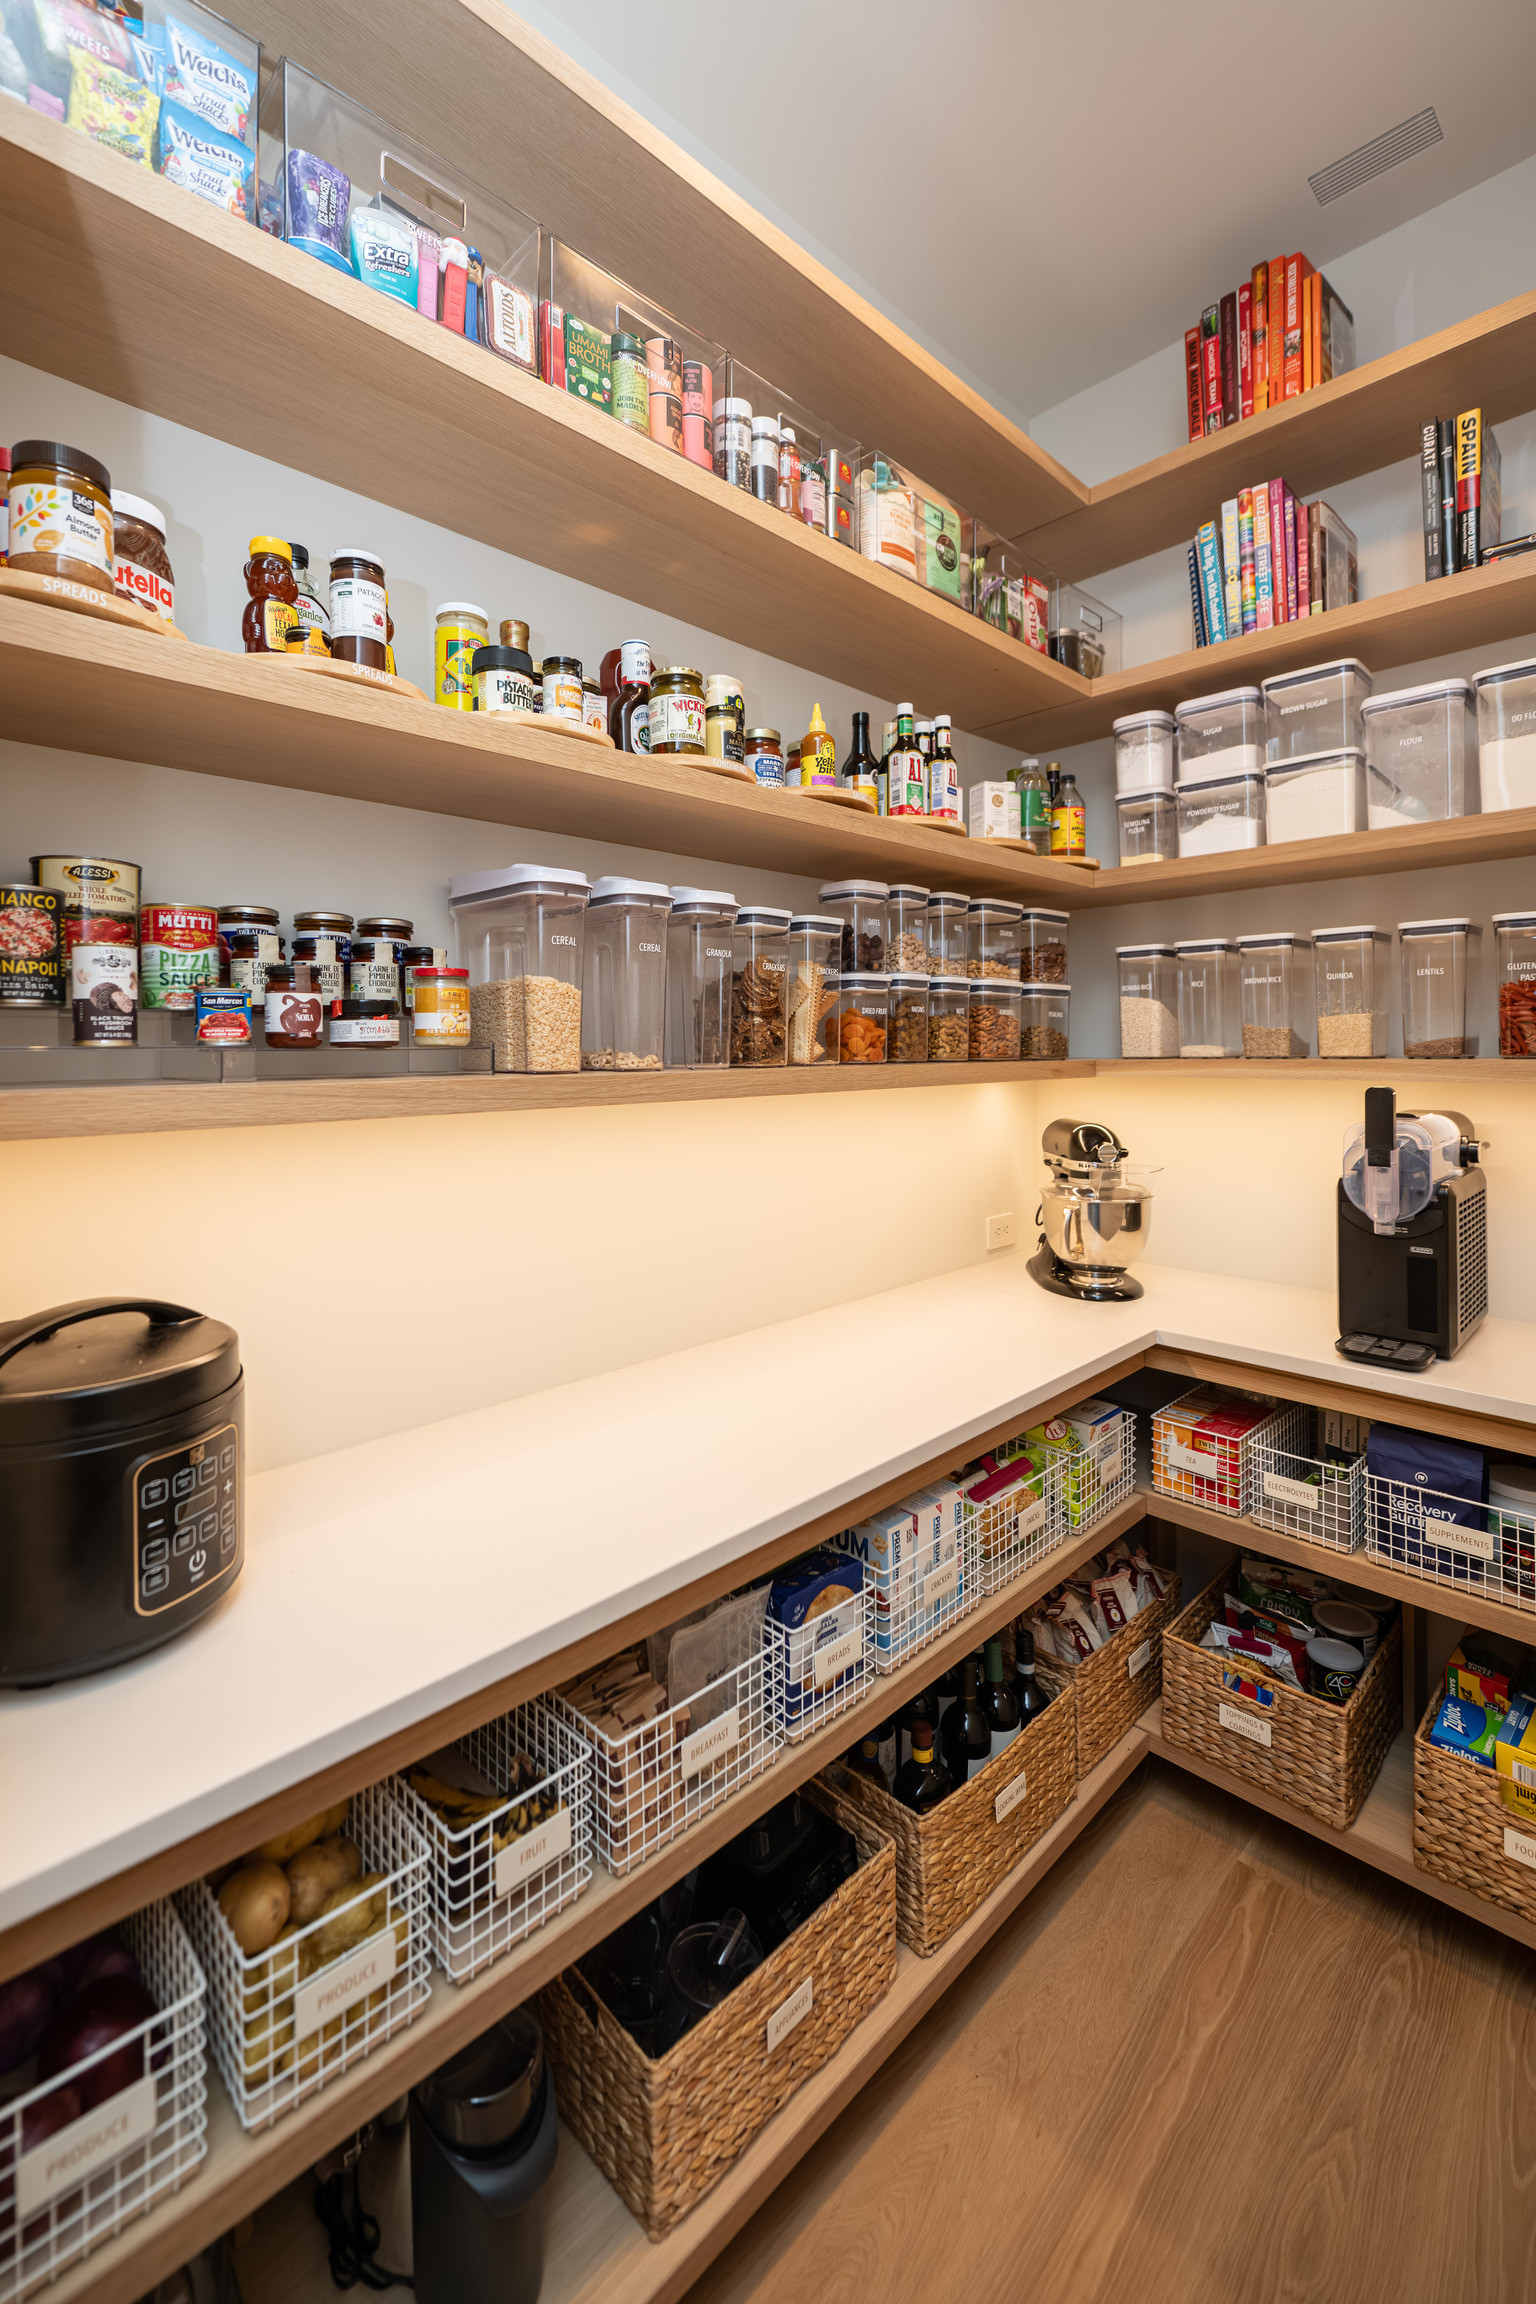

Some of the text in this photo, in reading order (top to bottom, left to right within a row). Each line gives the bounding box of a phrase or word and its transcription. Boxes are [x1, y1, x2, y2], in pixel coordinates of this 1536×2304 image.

[175, 41, 248, 95] Welch's
[191, 95, 230, 126] Snacks
[200, 92, 227, 112] Fruit
[189, 171, 228, 198] Snacks
[198, 168, 225, 187] Fruit
[319, 175, 333, 213] BREAKERS
[330, 186, 338, 213] CUBES
[407, 221, 443, 252] SWEETS
[364, 243, 411, 267] Extra
[365, 260, 411, 279] Refreshers
[500, 289, 517, 353] ALTOIDS
[572, 331, 609, 360] UMAMI
[1188, 341, 1198, 365] MAN
[1272, 315, 1281, 377] CHAMELEON
[568, 340, 611, 375] BROTH
[618, 351, 637, 370] SPICE
[637, 366, 673, 391] OVERFLOW
[1207, 342, 1218, 405] HOMESICK TEXAN
[616, 402, 647, 416] MADNESS
[617, 395, 646, 407] JOIN THE
[1189, 367, 1201, 434] MADE MEALS
[1462, 418, 1478, 476] SPAIN
[74, 494, 94, 512] 365
[65, 513, 101, 535] Almond
[1256, 494, 1267, 546] ELIZABETH
[1467, 510, 1477, 534] MARIO
[70, 525, 98, 541] Butter
[1272, 504, 1284, 605] EXTRAORDINARY CELEBRATIONS
[1467, 535, 1476, 560] BATALI
[1225, 515, 1239, 623] BASQUE COUNTRY
[1258, 548, 1268, 583] STREET
[43, 577, 108, 607] SPREADS
[114, 565, 173, 608] utella
[1203, 542, 1221, 633] The Big Fun Kids Cookbook
[274, 611, 294, 624] LOCAL
[1028, 601, 1039, 645] JELL-O
[352, 664, 393, 686] SPREADS
[503, 692, 533, 710] BUTTER
[1280, 698, 1328, 716] BROWN SUGAR
[1524, 711, 1536, 720] FLO
[1202, 726, 1223, 737] SUGAR
[1399, 735, 1423, 747] FLOUR
[1186, 802, 1240, 818] POWDERED SUGAR
[1123, 818, 1151, 829] SEMOLINA
[1128, 826, 1145, 835] FLOUR
[72, 866, 112, 880] ALESSI
[78, 885, 106, 895] WHOLE
[87, 893, 127, 904] TOMATOES
[0, 892, 57, 910] IANCO
[158, 914, 213, 930] MUTTI
[867, 918, 881, 927] DATES
[551, 935, 577, 947] CEREAL
[639, 942, 662, 953] CEREAL
[159, 950, 211, 972] PIZZA
[706, 948, 732, 958] GRANOLA
[333, 965, 340, 973] DE
[368, 964, 397, 973] CARNE DE
[368, 972, 397, 980] PIMIENTO
[762, 961, 786, 972] CRACKERS
[817, 967, 839, 976] CRACKERS
[1326, 971, 1354, 980] QUINOA
[1417, 967, 1445, 976] LENTILS
[1506, 962, 1536, 971] GLUTEN
[25, 981, 54, 990] Sauce
[159, 972, 211, 987] SAUCE
[368, 979, 397, 988] CHORICERO
[1121, 982, 1152, 992] BOMBA RICE
[1191, 980, 1204, 988] RICE
[1244, 975, 1282, 985] BROWN RICE
[203, 997, 243, 1005] San Marcos
[911, 1006, 925, 1014] RAISINS
[295, 1012, 314, 1022] ÑORA
[861, 1007, 888, 1015] DRIED FRUIT
[956, 1007, 965, 1015] NUTS
[359, 1025, 377, 1034] green
[1185, 1456, 1198, 1466] TEA
[1267, 1480, 1315, 1502] ELECTROLYTES
[1389, 1496, 1457, 1523] Recovery
[1429, 1526, 1490, 1551] SUPPLEMENTS
[930, 1572, 953, 1592] CRACKERS
[1254, 1629, 1280, 1646] CRISPY
[827, 1644, 850, 1666] BREADS
[705, 1662, 731, 1684] Sugar
[1328, 1675, 1352, 1697] 4C
[1225, 1708, 1265, 1732] TOPPINGS &
[1443, 1703, 1467, 1735] Ziploc
[1229, 1721, 1262, 1742] COATINGS
[690, 1726, 730, 1762] BREAKFAST
[1482, 1733, 1496, 1755] SANDWICH
[1015, 1780, 1026, 1796] WINE
[519, 1836, 547, 1867] FRUIT
[316, 1961, 378, 2013] PRODUCE
[774, 1992, 810, 2037] APPLIANCES
[45, 2111, 129, 2183] PRODUCE
